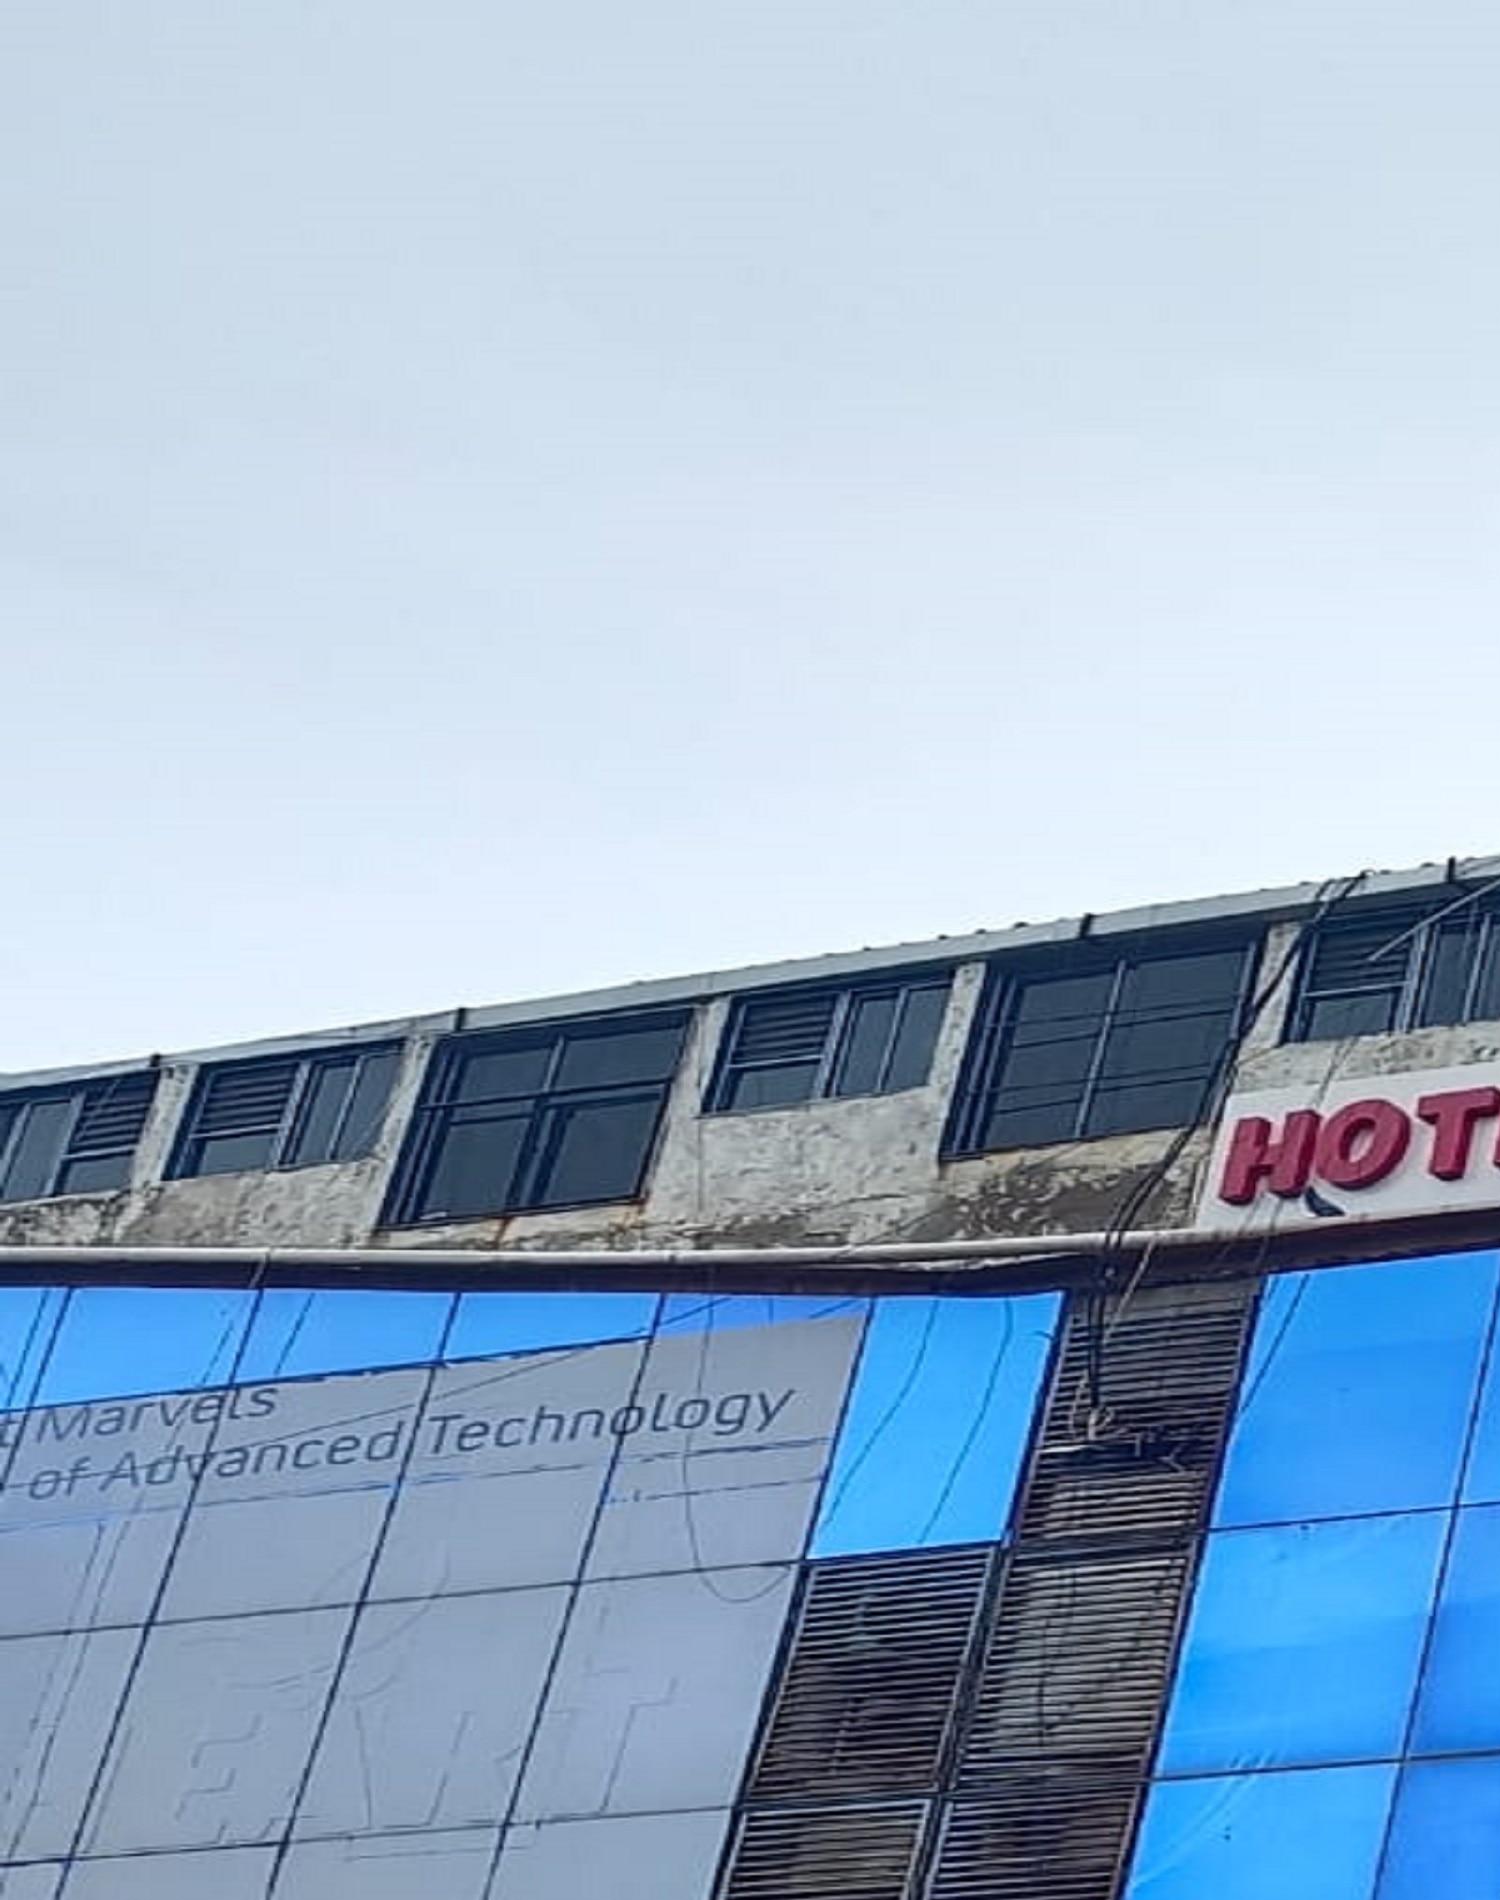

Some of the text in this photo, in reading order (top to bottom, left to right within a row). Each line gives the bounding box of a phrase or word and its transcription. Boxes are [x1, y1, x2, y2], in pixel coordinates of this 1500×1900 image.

[28, 1388, 797, 1500] of Advanced Technology
[38, 1386, 280, 1442] Marvels
